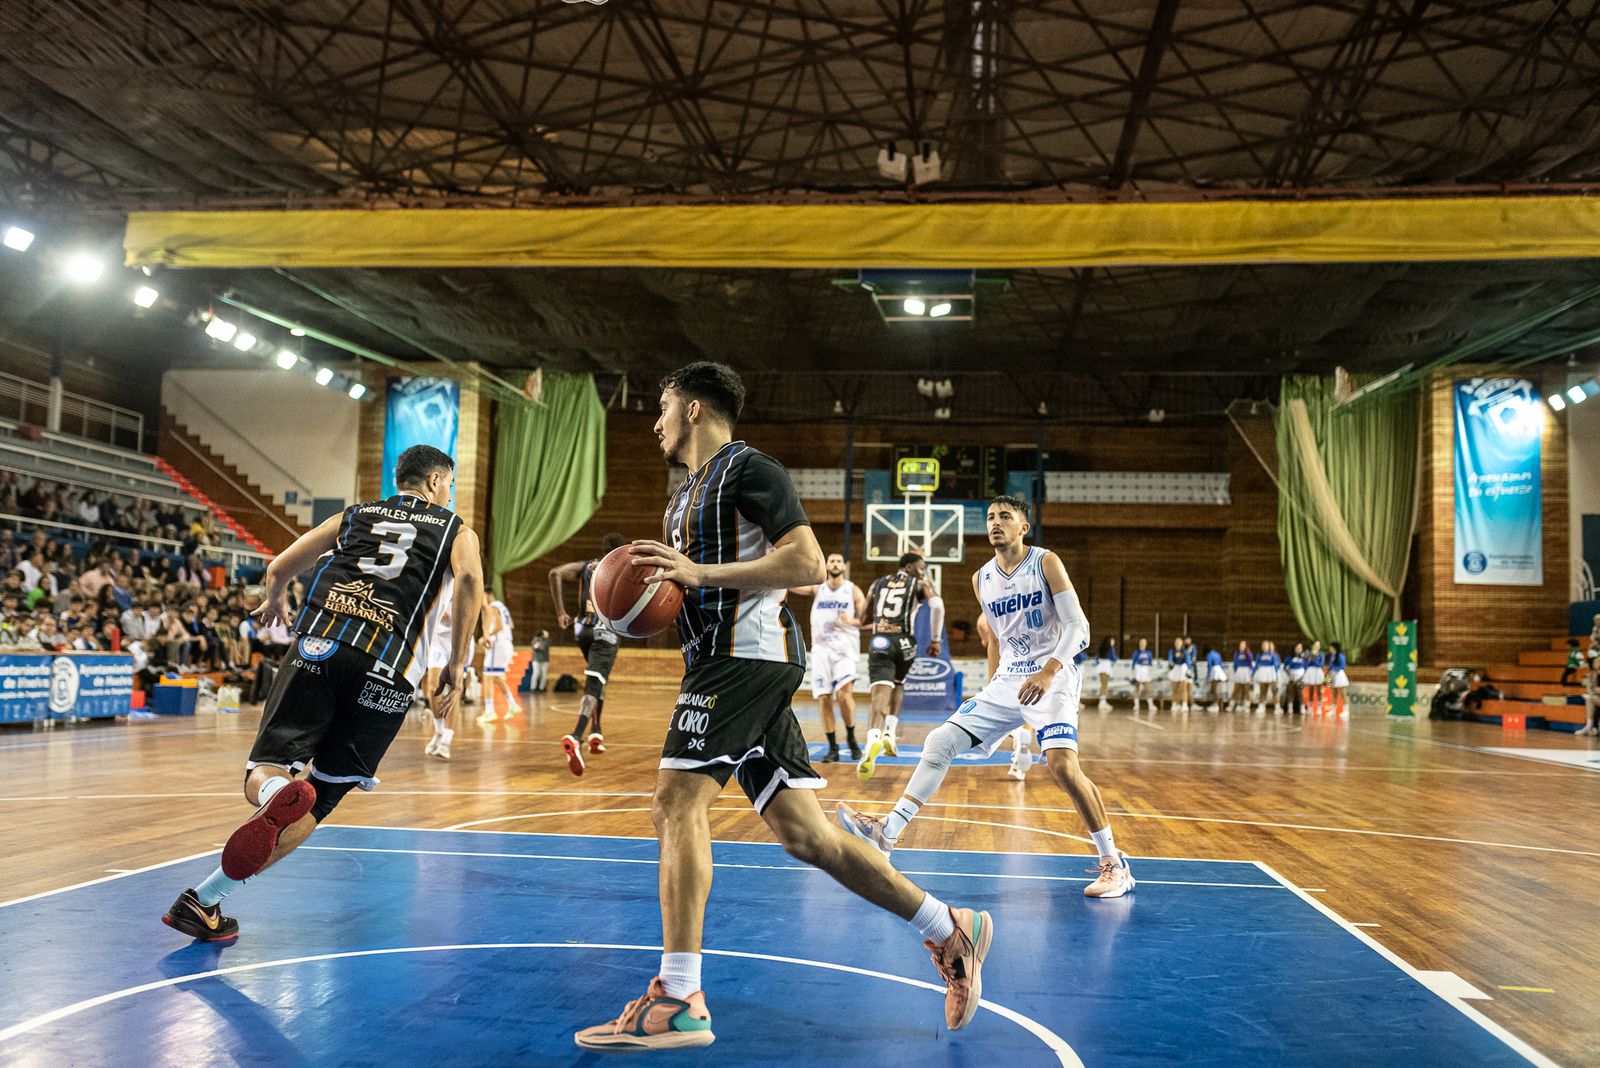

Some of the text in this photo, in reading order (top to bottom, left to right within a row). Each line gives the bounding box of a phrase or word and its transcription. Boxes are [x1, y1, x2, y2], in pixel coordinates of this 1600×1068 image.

[359, 506, 447, 527] MORALES MUÑOZ
[357, 521, 417, 581] 3
[327, 590, 358, 608] BAR
[816, 600, 849, 610] Huelva
[876, 587, 907, 618] 15
[988, 590, 1043, 618] Huelva
[1024, 609, 1044, 630] 10
[1014, 665, 1043, 674] SALUDA
[360, 690, 376, 702] DE
[364, 680, 414, 702] DIPUTACIÓ
[960, 700, 977, 715] 0
[678, 709, 709, 735] ORO
